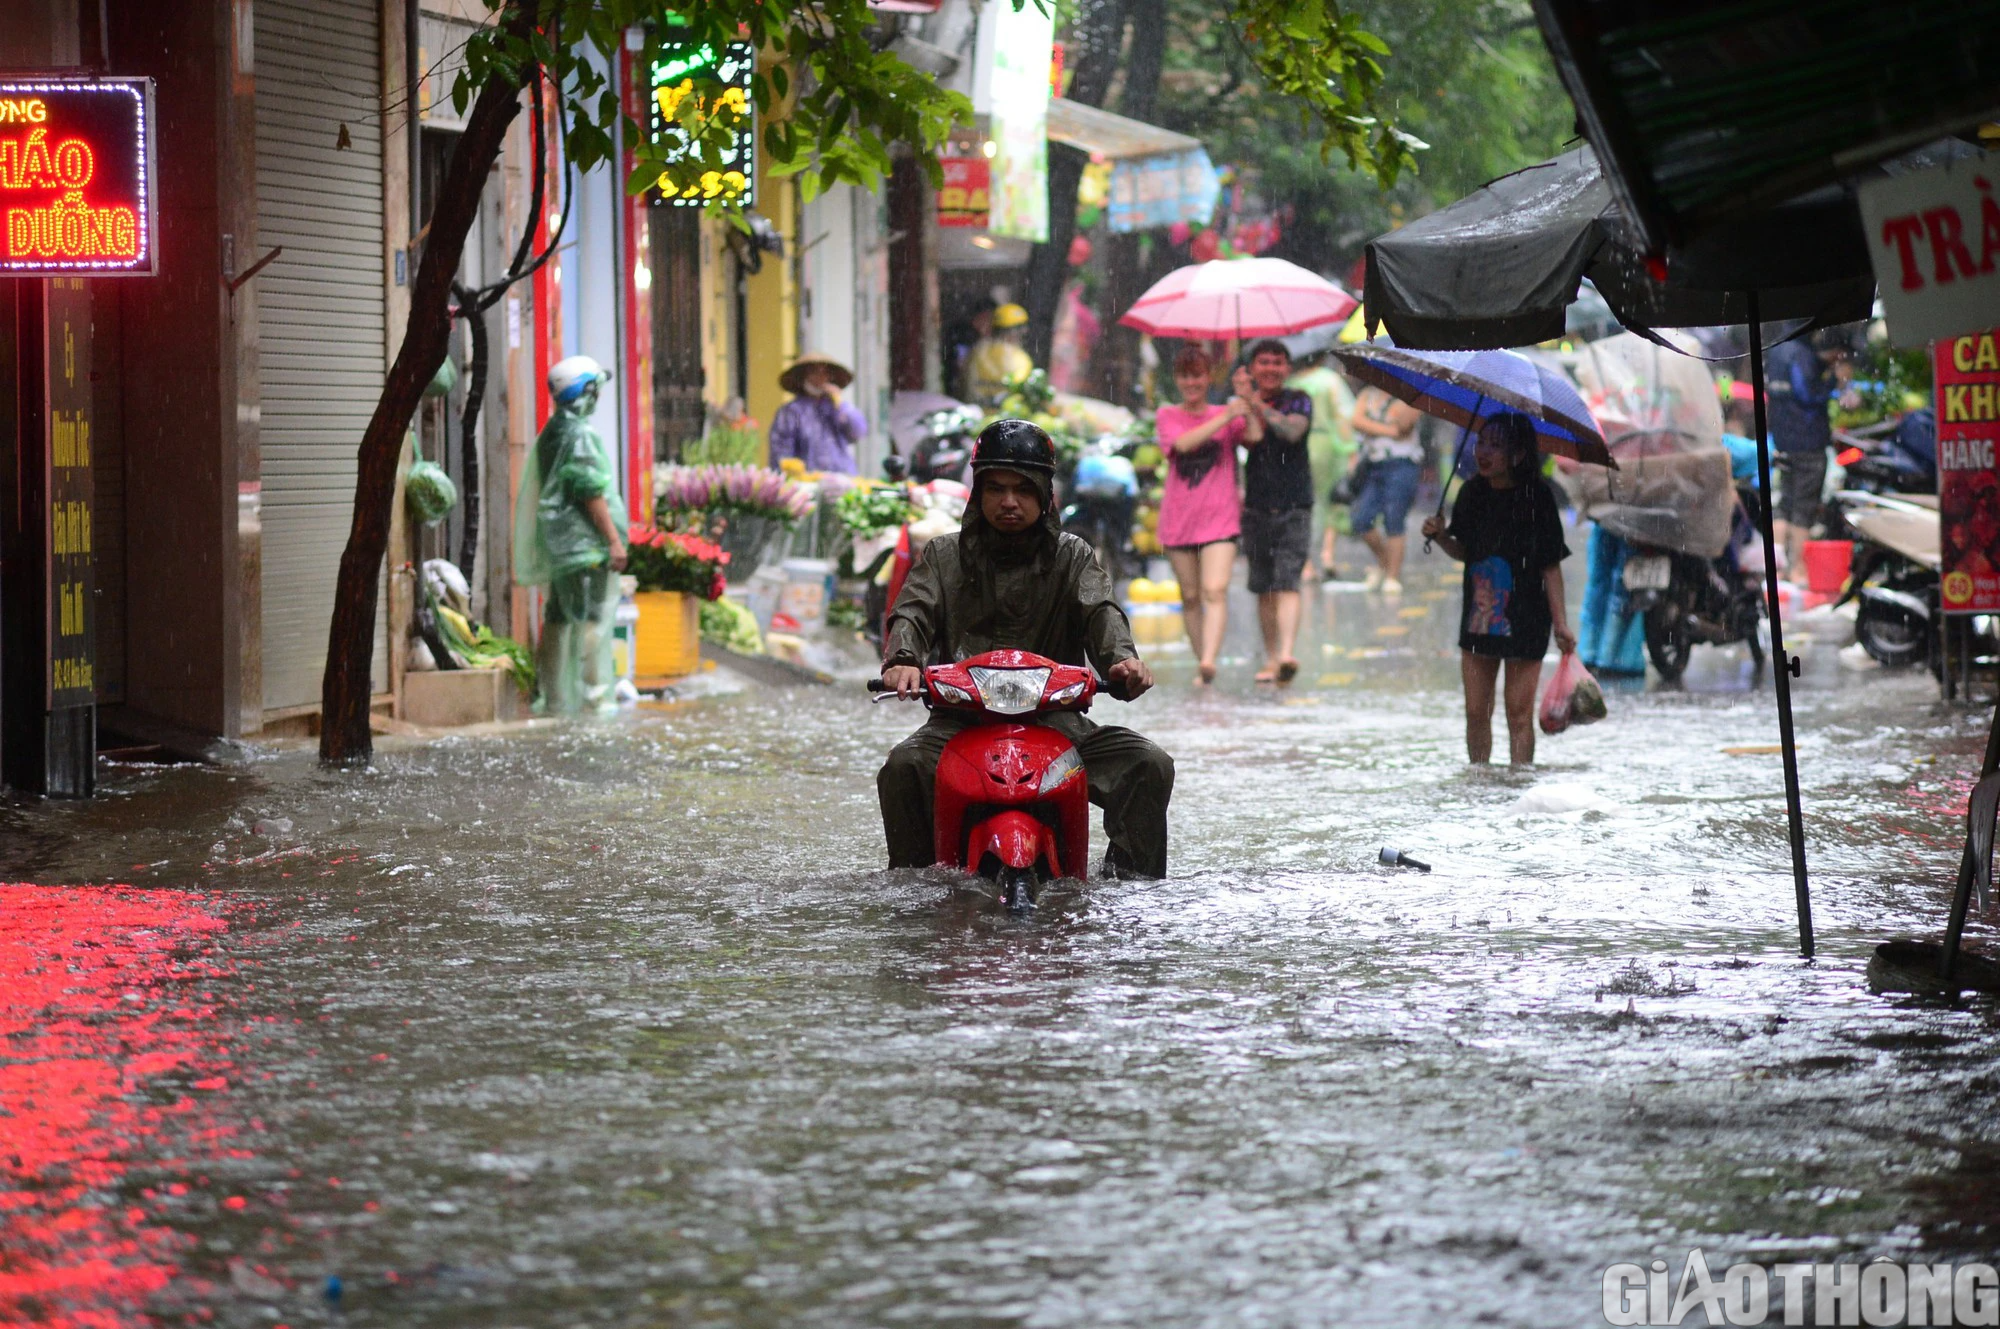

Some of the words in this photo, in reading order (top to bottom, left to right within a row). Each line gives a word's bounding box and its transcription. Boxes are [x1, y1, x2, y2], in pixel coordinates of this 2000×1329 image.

[9, 191, 135, 257] DƯỠNG
[1944, 384, 2000, 422] KH
[1941, 432, 1995, 471] HÀNG
